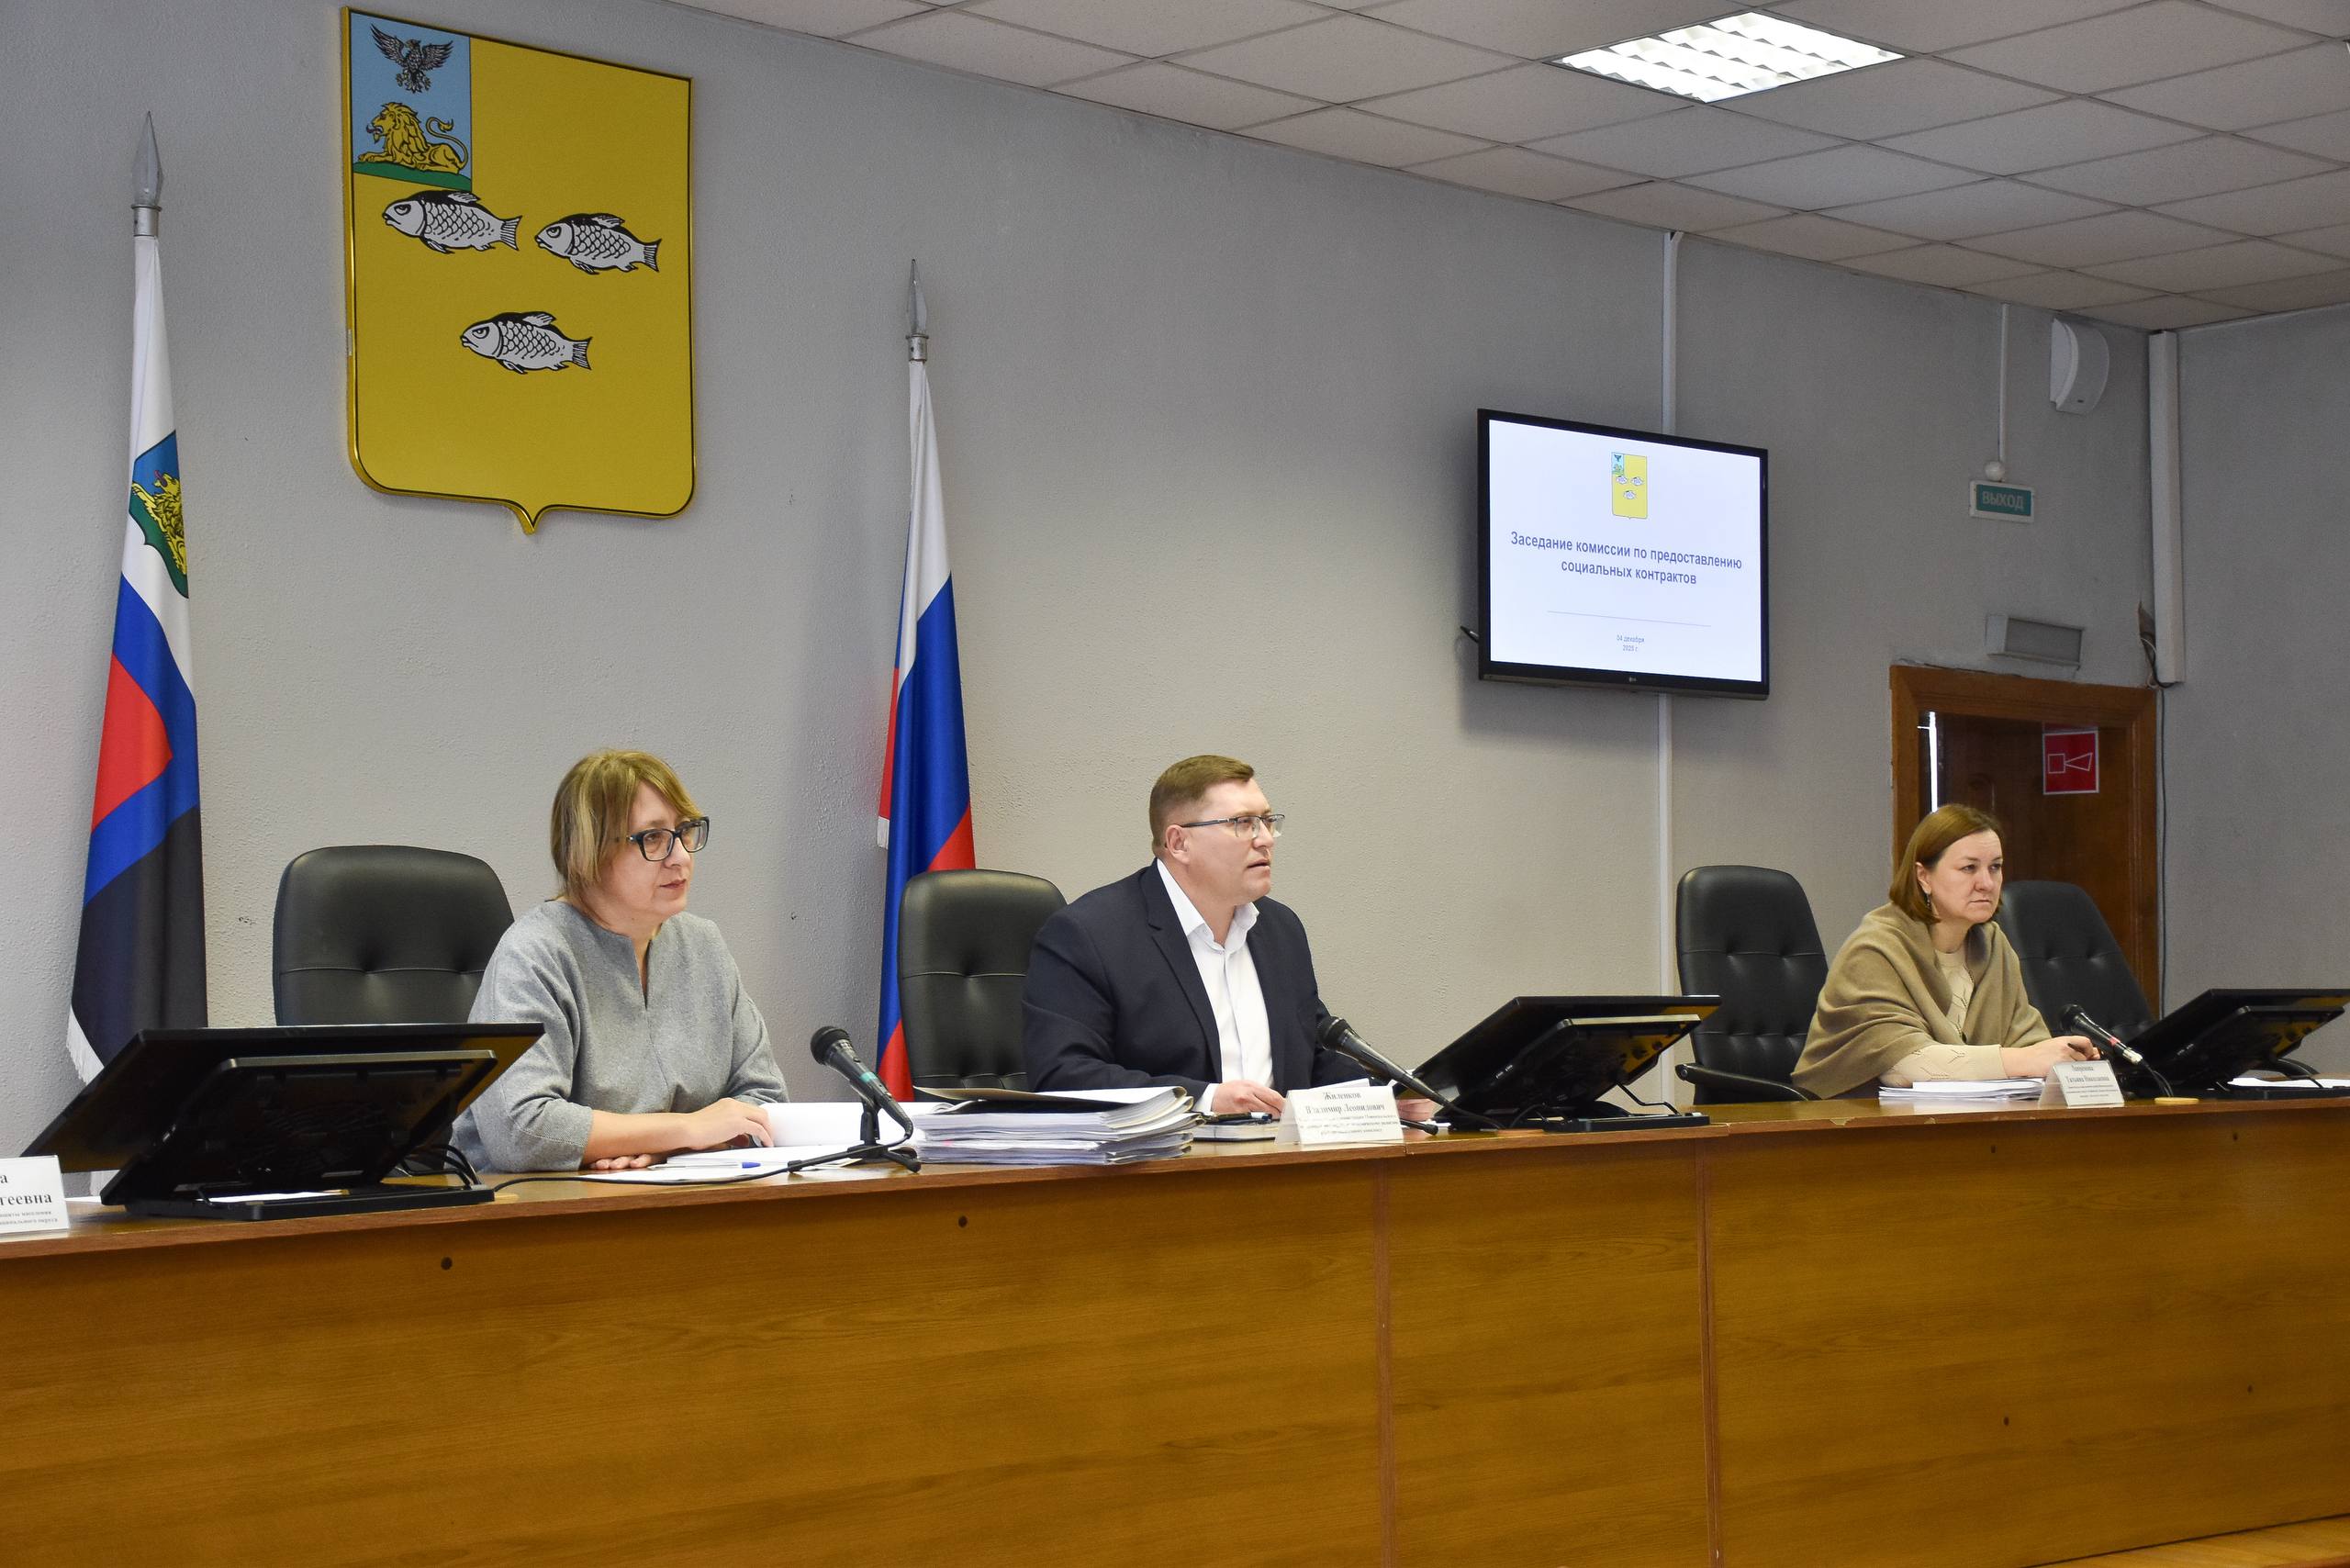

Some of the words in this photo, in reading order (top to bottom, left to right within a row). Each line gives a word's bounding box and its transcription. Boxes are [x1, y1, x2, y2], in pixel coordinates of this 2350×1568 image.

[1983, 491, 2024, 511] ВЫХОД
[1511, 531, 1573, 551] Заседание
[1576, 541, 1630, 557] комиссии
[1634, 548, 1648, 558] по
[1651, 550, 1742, 569] предоставлению
[1561, 561, 1632, 578] социальных
[1635, 568, 1697, 585] контрактов
[1324, 1092, 1361, 1101] Жиленков
[1305, 1104, 1342, 1115] Владимир
[1343, 1103, 1385, 1113] Леонидович
